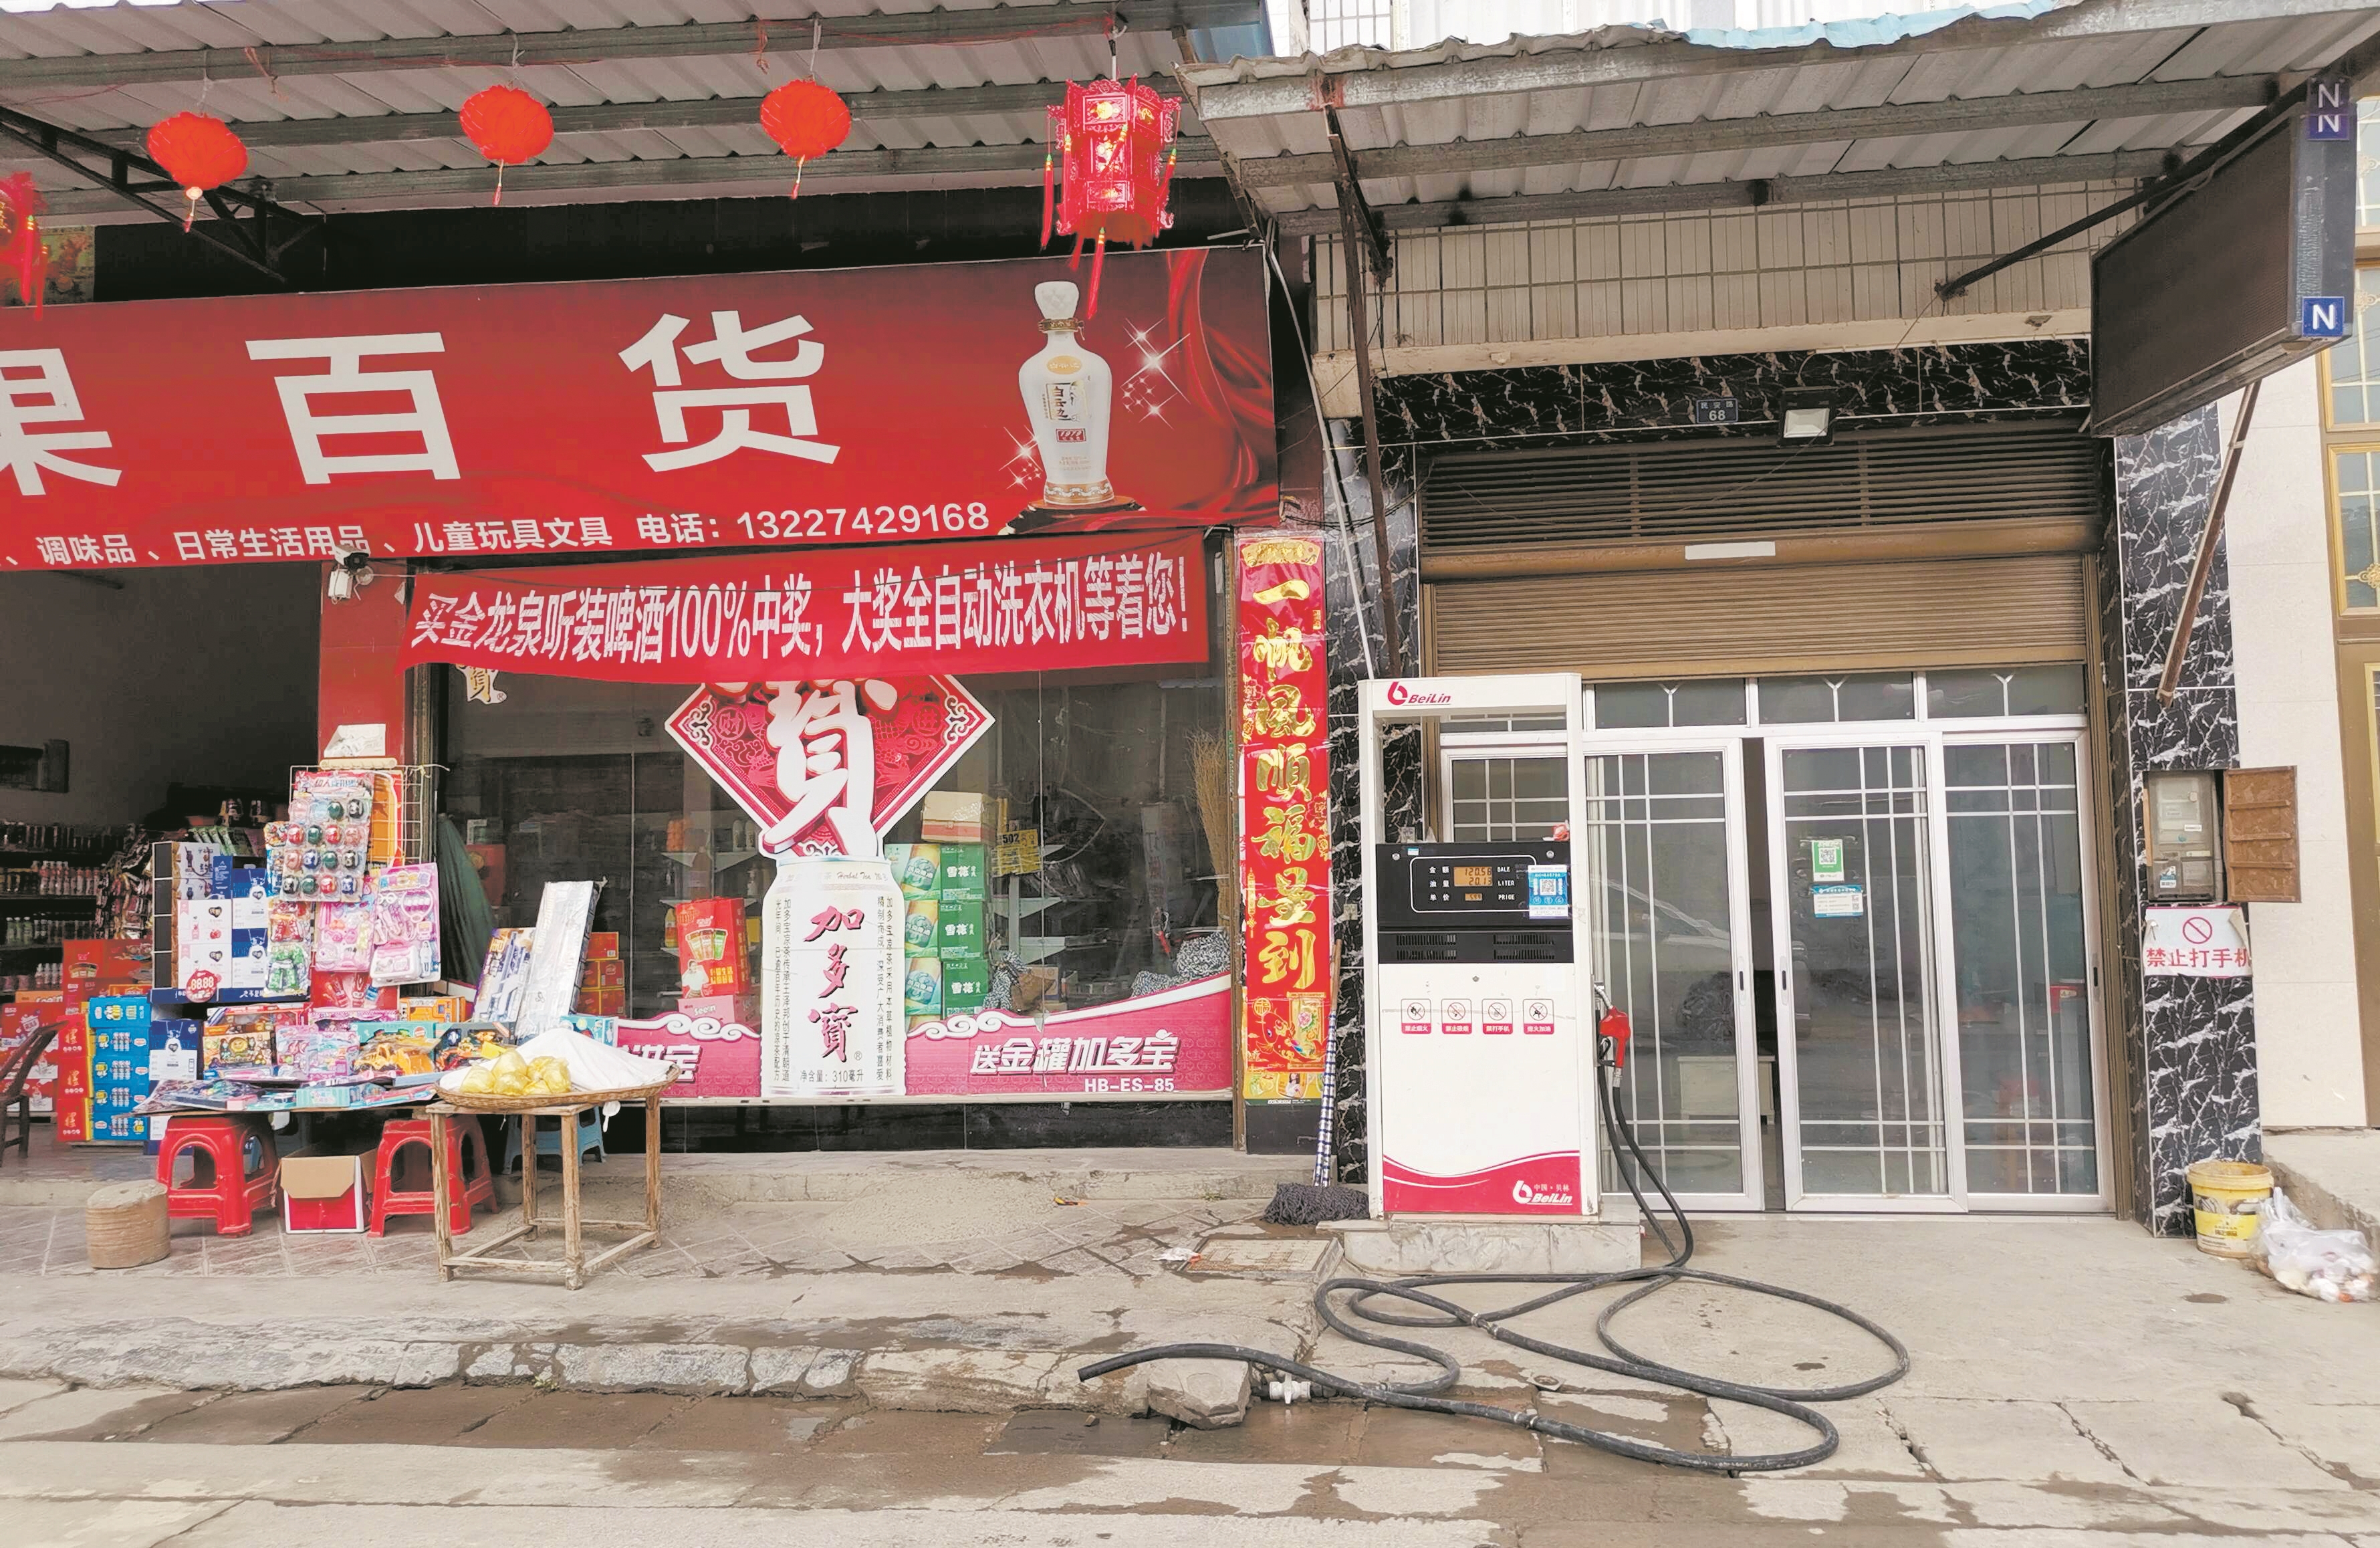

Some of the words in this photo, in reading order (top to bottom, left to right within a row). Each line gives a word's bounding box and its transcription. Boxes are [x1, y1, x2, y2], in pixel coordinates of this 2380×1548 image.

[2318, 84, 2339, 108] N
[2312, 304, 2335, 329] N
[1709, 410, 1726, 421] 68
[1408, 693, 1451, 704] BeiLin
[1002, 834, 1020, 844] 502
[1429, 893, 1450, 901] 单价
[2146, 947, 2250, 968] 禁止打手机
[1084, 1078, 1175, 1093] HB-ES-85
[1532, 1193, 1572, 1204] BeiLin
